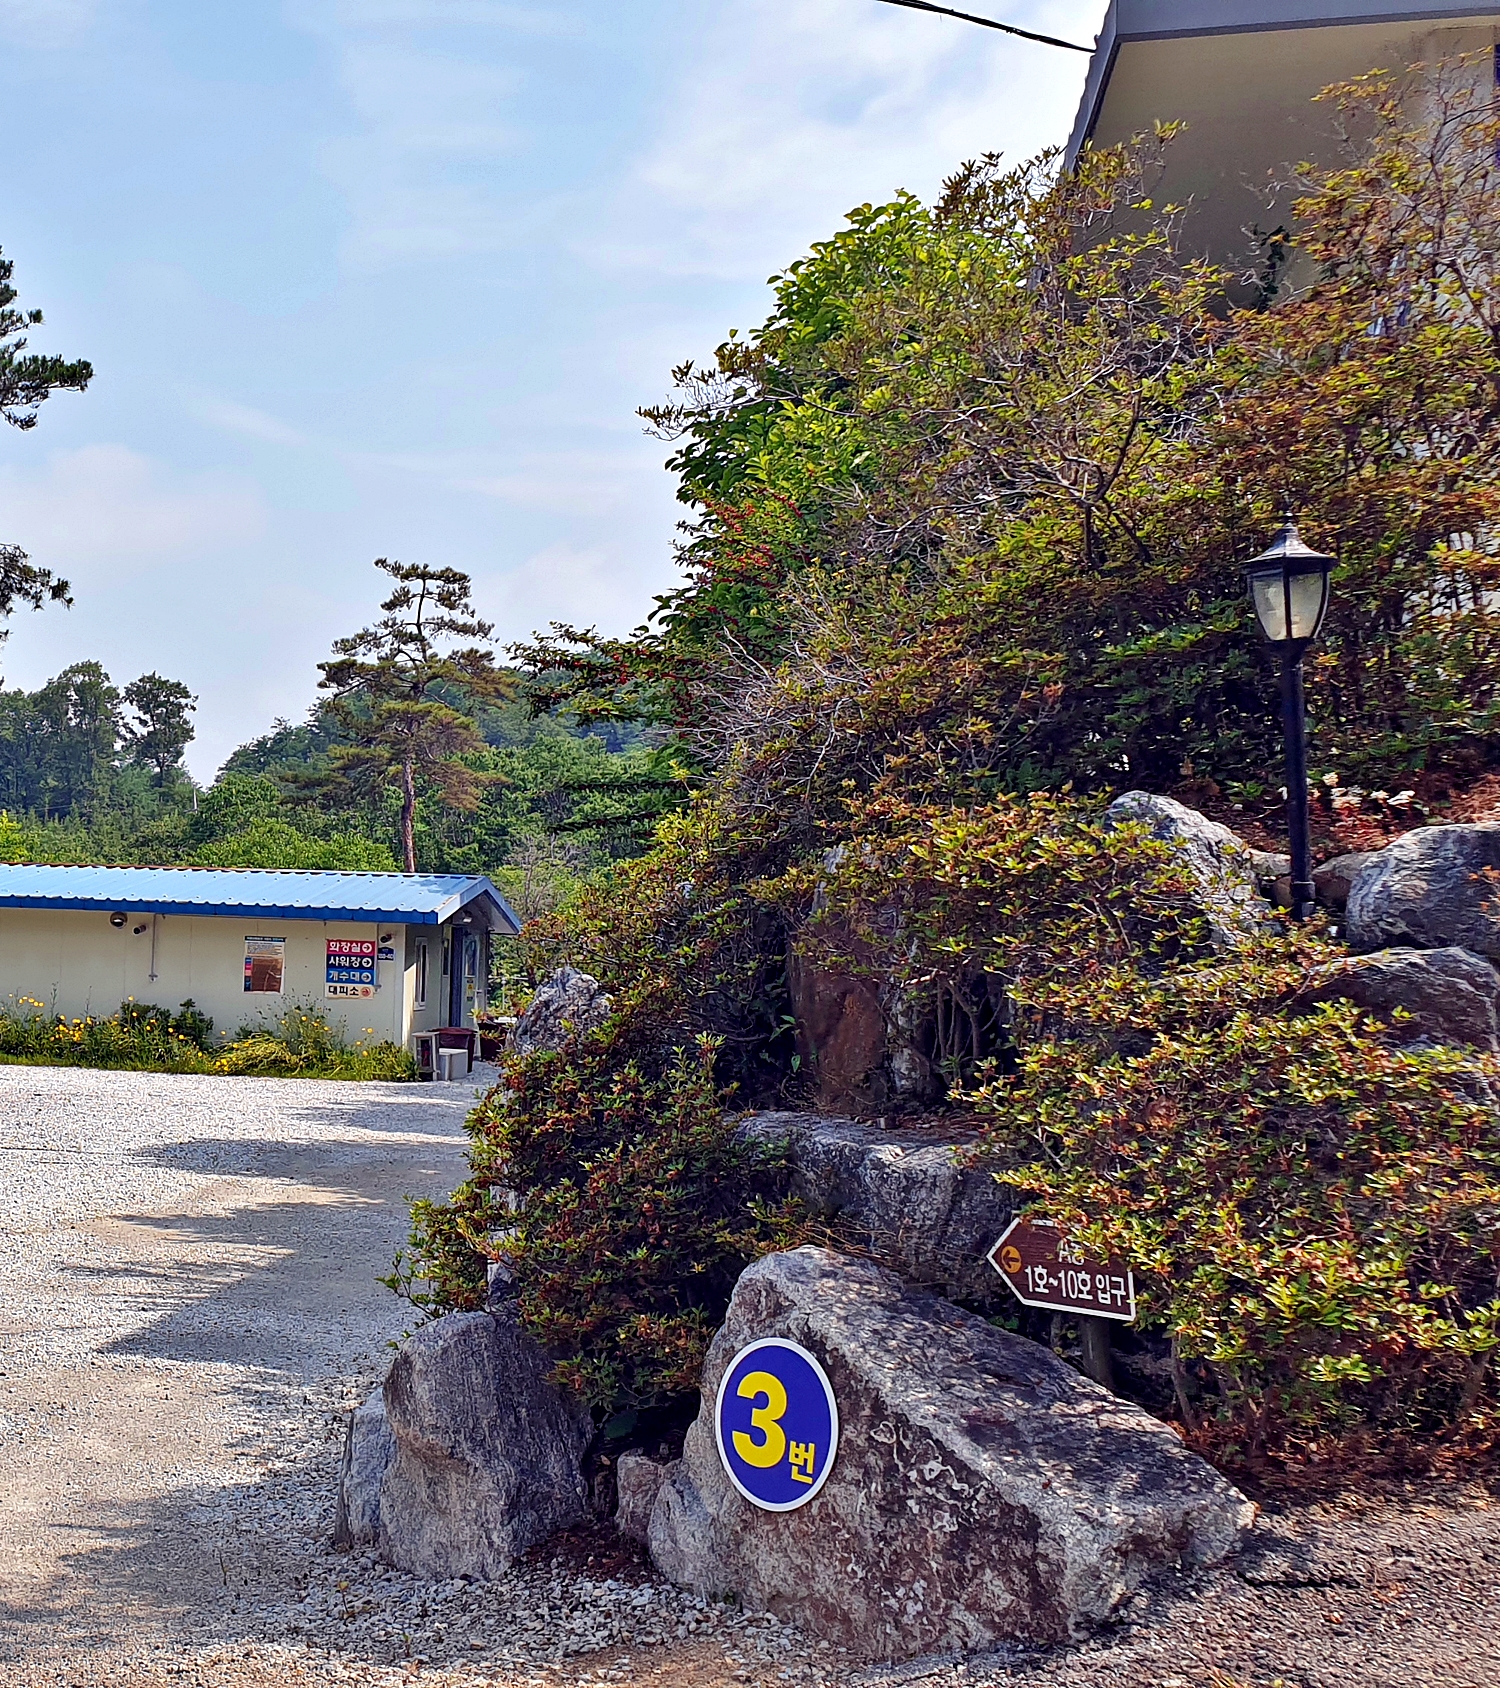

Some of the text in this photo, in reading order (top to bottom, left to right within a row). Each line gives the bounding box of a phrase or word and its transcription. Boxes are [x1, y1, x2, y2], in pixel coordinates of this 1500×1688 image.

[329, 941, 361, 953] 화장실
[329, 970, 360, 982] 개수대
[328, 985, 359, 996] 대피소
[1024, 1265, 1126, 1306] 1호~10호 입구
[732, 1371, 815, 1485] 3번
